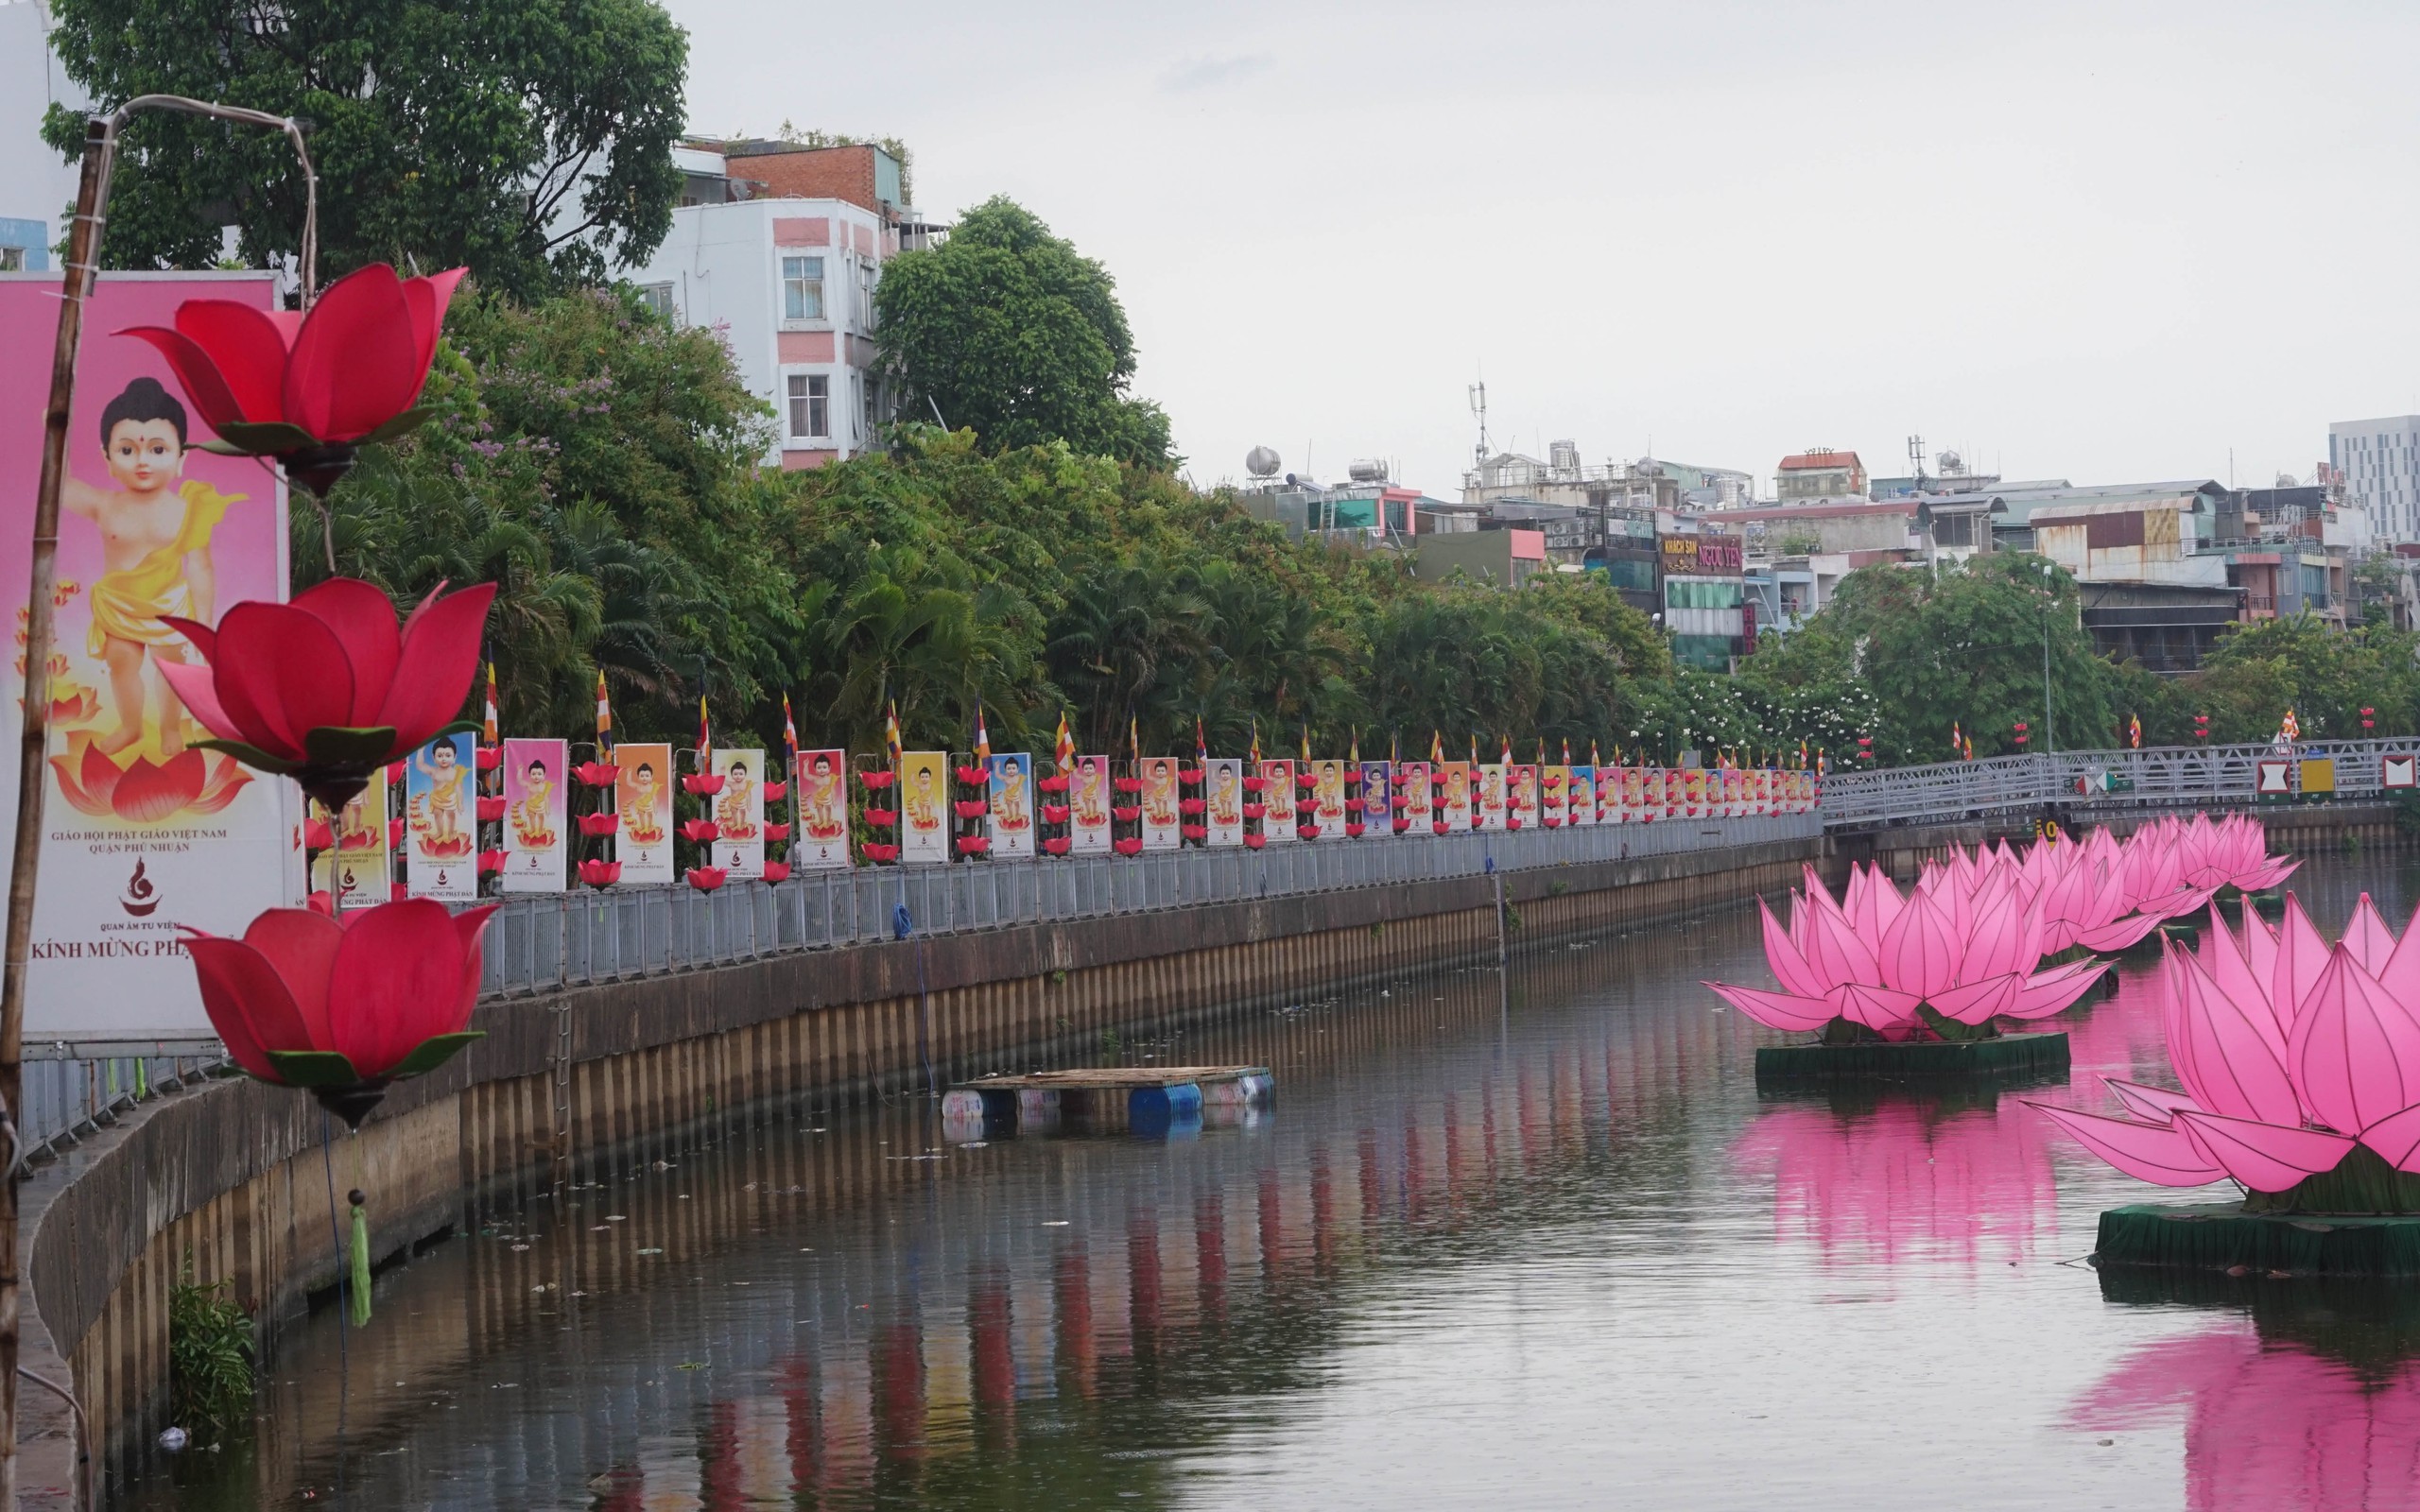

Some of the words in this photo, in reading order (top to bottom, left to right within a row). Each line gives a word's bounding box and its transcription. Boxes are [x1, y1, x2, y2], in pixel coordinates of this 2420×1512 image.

[1665, 537, 1685, 555] KHÁCH
[1685, 540, 1698, 558] SẠN
[51, 830, 81, 841] GIÁO
[84, 830, 104, 842] HỘI
[108, 830, 137, 842] PHẬT
[140, 829, 169, 840] GIÁO
[172, 829, 198, 840] VIỆT
[201, 830, 227, 839] NAM
[89, 842, 121, 854] QUẬN
[125, 842, 147, 853] PHÚ
[151, 842, 190, 853] NHUẬN
[100, 922, 125, 932] QUAN
[127, 920, 139, 931] ÂM
[142, 922, 155, 931] TU
[157, 920, 181, 933] VIỆN
[31, 937, 82, 959] KÍNH
[87, 936, 148, 958] MỪNG
